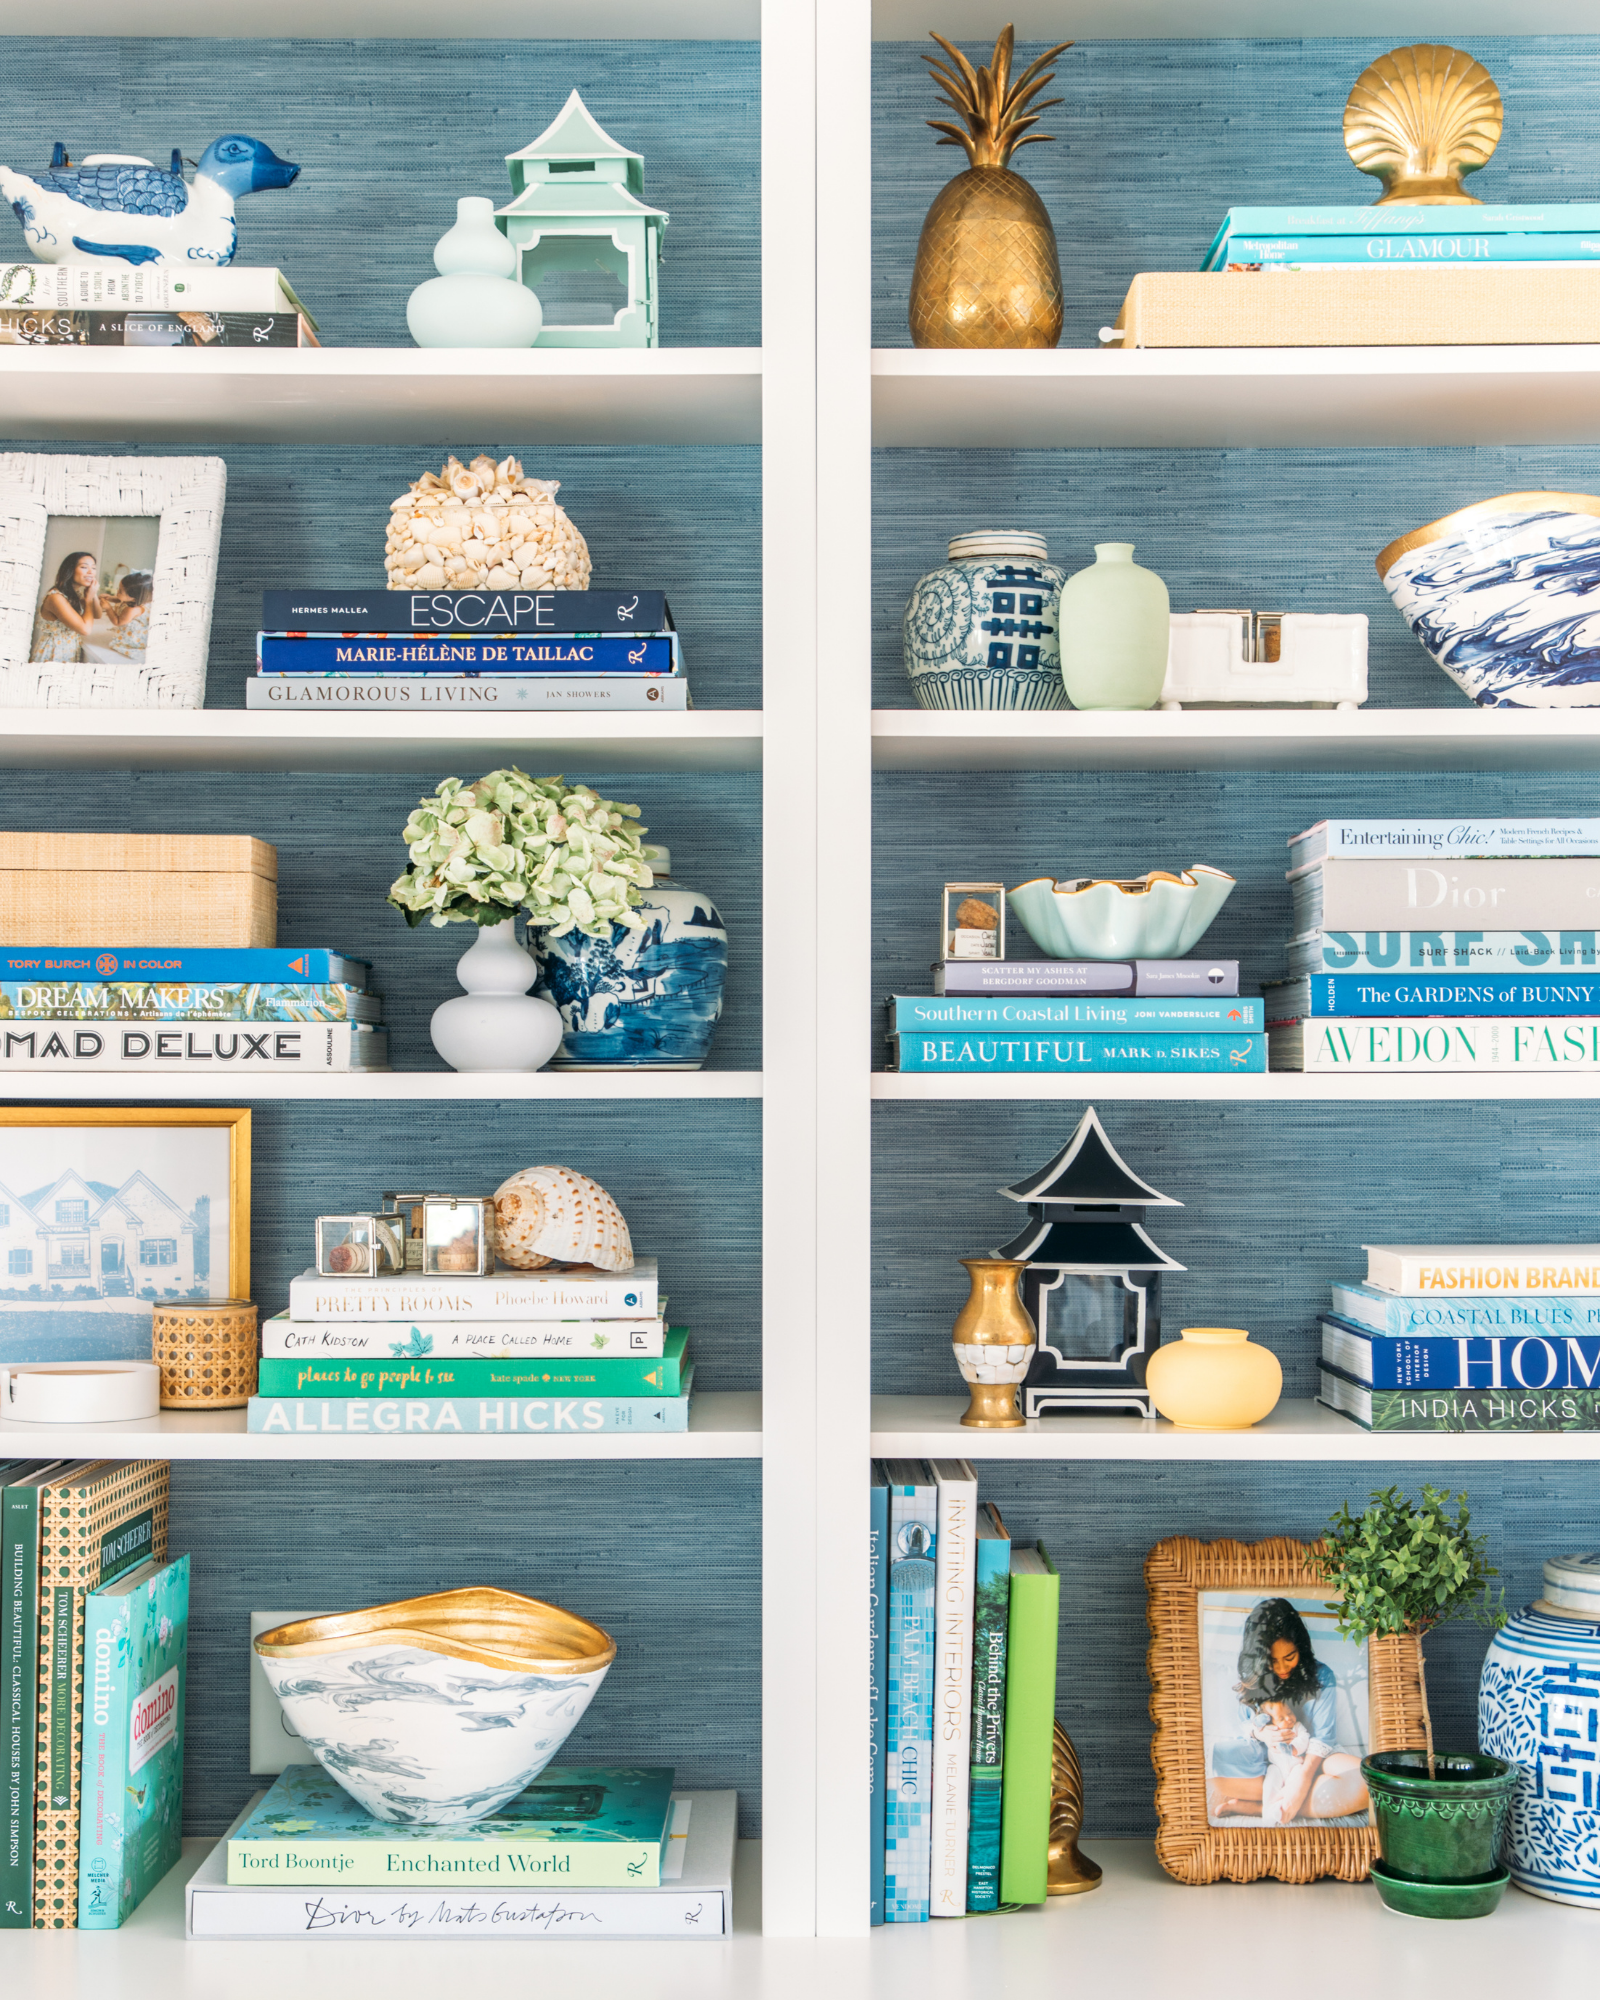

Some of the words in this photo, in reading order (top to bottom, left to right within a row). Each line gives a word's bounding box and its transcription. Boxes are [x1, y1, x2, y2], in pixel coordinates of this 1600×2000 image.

[1243, 241, 1298, 251] Metropolitan
[1259, 250, 1285, 259] Home
[1367, 239, 1490, 258] GLAMOUR
[58, 267, 68, 307] SOUTHERN
[135, 272, 143, 293] ZYDECO
[94, 292, 102, 302] THE
[0, 318, 70, 335] HICKS
[111, 324, 143, 332] SLICE
[148, 324, 163, 332] OF
[168, 324, 224, 333] ENGLAND
[411, 595, 555, 626] ESCAPE
[336, 644, 476, 661] MARIE-HÉLÈNE
[482, 646, 508, 661] DE
[512, 646, 594, 661] TAILLAC
[268, 686, 410, 701] GLAMOROUS
[420, 686, 498, 702] LIVING
[1340, 828, 1444, 850] Entertaining
[1447, 825, 1495, 844] Chic!
[1401, 867, 1506, 909] Dior
[1419, 948, 1448, 956] SURF
[1454, 948, 1492, 956] SHACK
[7, 960, 41, 969] TORY
[45, 960, 91, 969] BURCH
[123, 960, 136, 969] IN
[138, 960, 182, 969] COLOR
[16, 987, 109, 1009] DREAM
[120, 987, 224, 1009] MAKERS
[265, 997, 325, 1007] Flammarion
[1357, 987, 1390, 1002] The
[1395, 987, 1494, 1002] GARDENS
[1499, 986, 1517, 1002] of
[1522, 987, 1594, 1002] BUNNY
[914, 1005, 997, 1021] Southern
[1003, 1005, 1068, 1021] Coastal
[1075, 1006, 1127, 1025] Living
[121, 1030, 301, 1061] DELUXE
[922, 1042, 1091, 1062] BEAUTIFUL
[1103, 1048, 1151, 1058] MARK
[1171, 1048, 1220, 1058] SIKES
[1314, 1026, 1479, 1062] AVEDON
[1419, 1267, 1519, 1289] FASHION
[316, 1296, 390, 1313] PRETTY
[400, 1295, 473, 1312] ROOMS
[495, 1290, 550, 1306] Phoebe
[553, 1290, 608, 1305] Howard
[1411, 1309, 1506, 1325] COASTAL
[1511, 1308, 1573, 1324] BLUES
[285, 1332, 315, 1348] CATH
[322, 1330, 369, 1347] KIDSTON
[452, 1334, 459, 1344] A
[465, 1334, 496, 1345] PLACE
[502, 1334, 537, 1345] CALLED
[543, 1334, 573, 1345] HOME
[1405, 1341, 1411, 1351] OF
[298, 1366, 340, 1390] places
[344, 1367, 357, 1381] to
[361, 1371, 374, 1389] go
[379, 1366, 421, 1391] people
[425, 1369, 434, 1384] to
[438, 1372, 455, 1384] see
[491, 1373, 510, 1382] kate
[513, 1374, 539, 1385] spade
[262, 1401, 463, 1431] ALLEGRA
[479, 1401, 604, 1430] HICKS
[1402, 1399, 1478, 1418] INDIA
[1489, 1399, 1577, 1418] HICKS
[102, 1540, 116, 1568] TOM
[117, 1520, 151, 1558] SCHEERER
[946, 1499, 966, 1603] INVITING
[14, 1543, 23, 1598] BUILDING
[58, 1592, 68, 1618] TOM
[13, 1600, 22, 1662] BEAUTIFUL:
[904, 1616, 920, 1666] PALM
[56, 1620, 68, 1680] SCHEERER
[988, 1632, 1003, 1683] Behind
[94, 1627, 117, 1725] domino
[944, 1613, 963, 1740] INTERIORS
[12, 1665, 23, 1721] CLASSICAL
[56, 1682, 67, 1713] MORE
[987, 1687, 1000, 1710] the
[134, 1685, 174, 1740] domino
[903, 1673, 919, 1739] BEACH
[11, 1726, 20, 1768] HOUSES
[986, 1714, 1000, 1763] Privets
[56, 1718, 66, 1790] DECORATING
[11, 1772, 20, 1784] BY
[902, 1746, 918, 1795] CHIC
[98, 1780, 104, 1788] of
[946, 1754, 958, 1816] MELANIE
[11, 1787, 20, 1815] JOHN
[96, 1791, 104, 1846] DECORATING
[10, 1819, 19, 1867] SIMPSON
[944, 1820, 956, 1877] TURNER
[238, 1853, 279, 1869] Tord
[286, 1853, 354, 1873] Boontje
[387, 1854, 500, 1872] Enchanted
[508, 1855, 570, 1872] World
